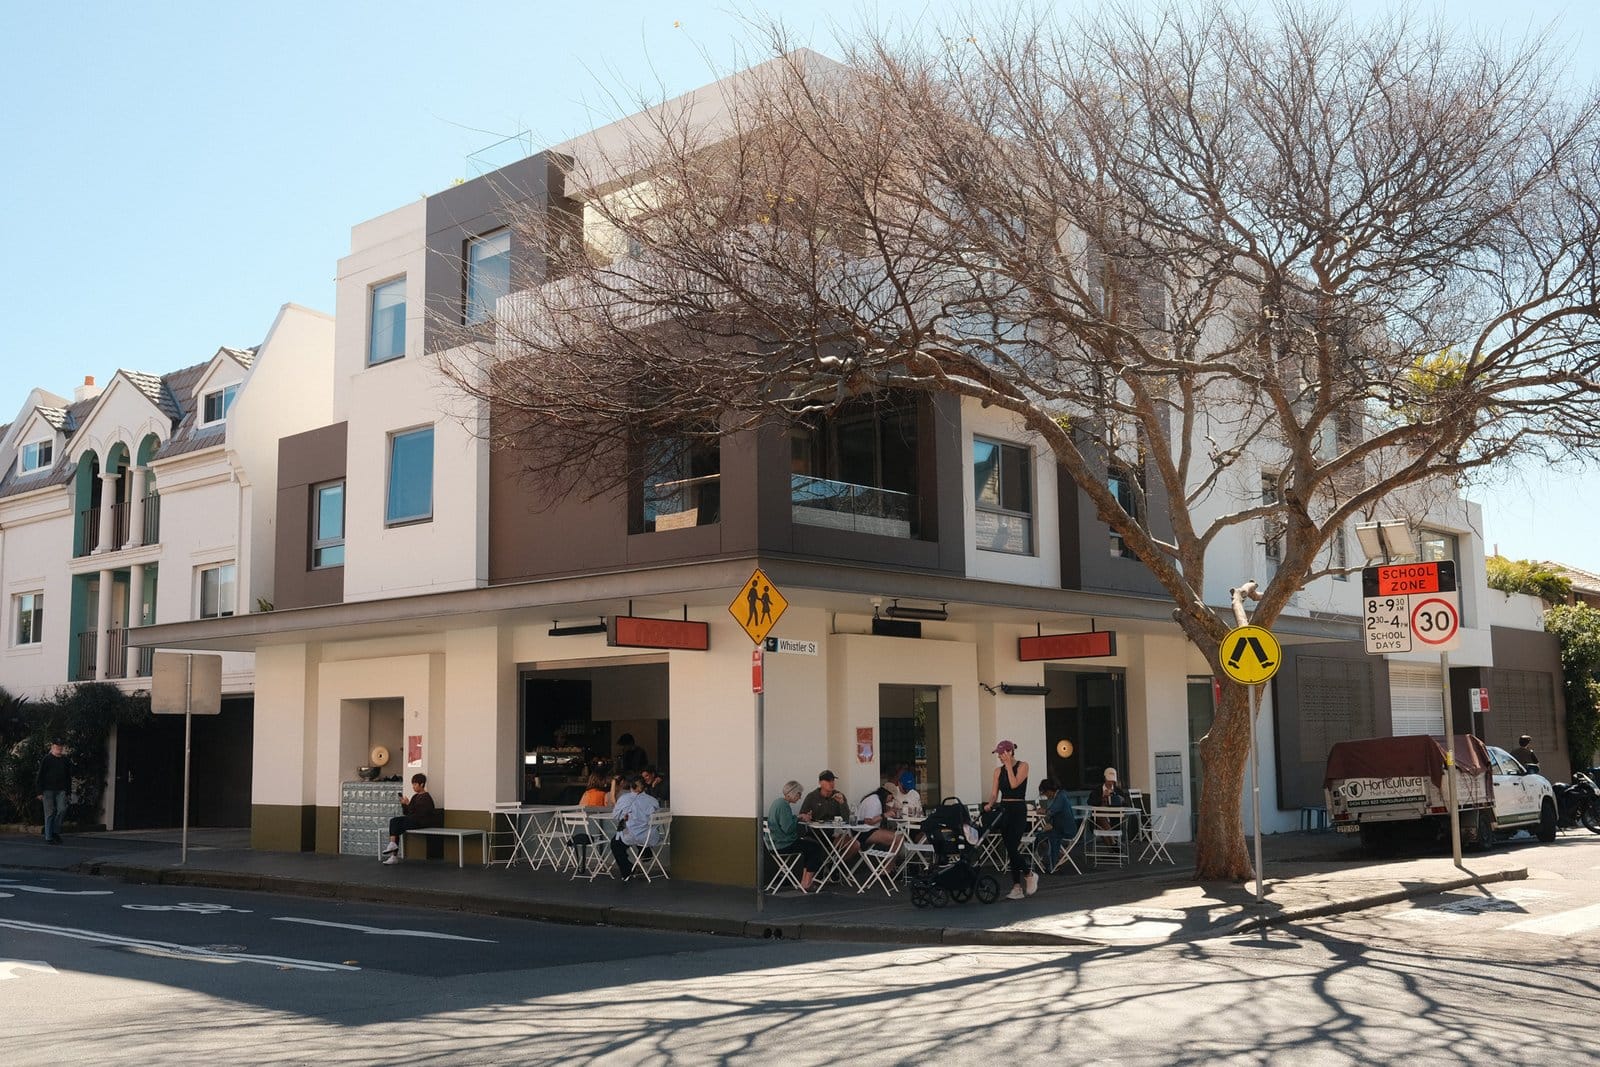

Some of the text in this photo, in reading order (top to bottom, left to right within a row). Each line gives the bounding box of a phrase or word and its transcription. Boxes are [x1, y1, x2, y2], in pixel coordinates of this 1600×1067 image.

[1382, 567, 1434, 580] SCHOOL
[1391, 580, 1427, 592] ZONE
[1420, 610, 1450, 632] 30
[1371, 631, 1406, 641] SCHOOL
[780, 640, 816, 653] Whistler St
[1375, 641, 1401, 649] DAYS
